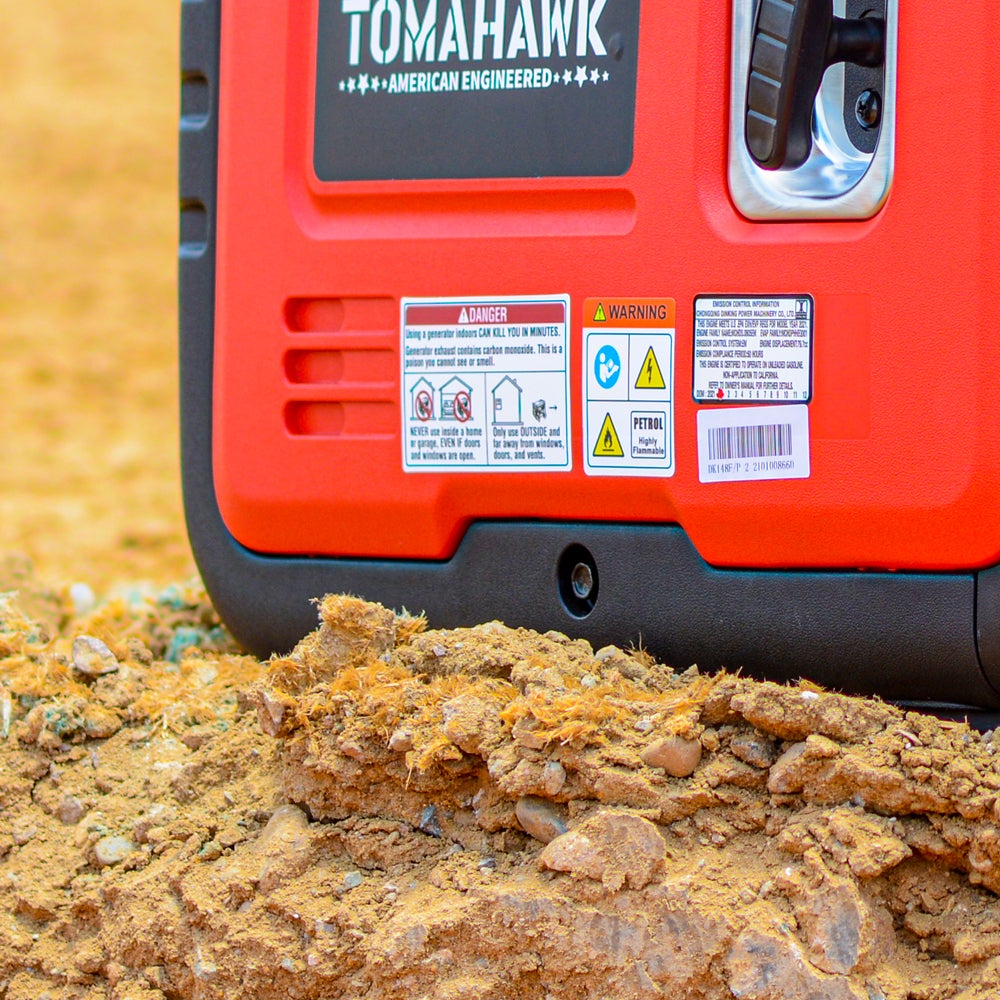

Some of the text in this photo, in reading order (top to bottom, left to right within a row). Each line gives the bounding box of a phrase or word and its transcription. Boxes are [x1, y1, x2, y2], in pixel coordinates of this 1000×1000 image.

[388, 68, 552, 93] AMERICAN ENGINEERED
[469, 306, 508, 323] DANGER
[608, 304, 667, 320] WARNING
[427, 329, 455, 341] generator
[456, 328, 477, 338] indoors
[479, 327, 491, 337] CAN
[493, 327, 506, 337] KILL
[507, 327, 520, 337] YOU
[522, 327, 528, 337] IN
[530, 326, 561, 337] MINUTES.
[434, 346, 456, 355] exhaust
[457, 345, 481, 355] contains
[483, 344, 503, 355] carbon
[537, 343, 550, 354] This
[551, 344, 557, 353] is
[425, 359, 435, 370] you
[437, 357, 456, 366] cannot
[476, 356, 496, 366] smell.
[633, 417, 663, 430] PETROL
[410, 426, 429, 436] NEVER
[430, 428, 440, 436] use
[442, 426, 459, 436] inside
[466, 427, 482, 436] home
[493, 426, 561, 438] Only use OUTSIDE and
[440, 437, 456, 447] EVEN
[457, 437, 463, 447] IF
[464, 438, 481, 448] doors
[503, 440, 518, 450] away
[520, 439, 534, 448] from
[638, 437, 657, 448] Highly
[422, 450, 447, 460] windows
[448, 452, 458, 460] are
[514, 450, 526, 459] and
[632, 445, 664, 455] Flammable
